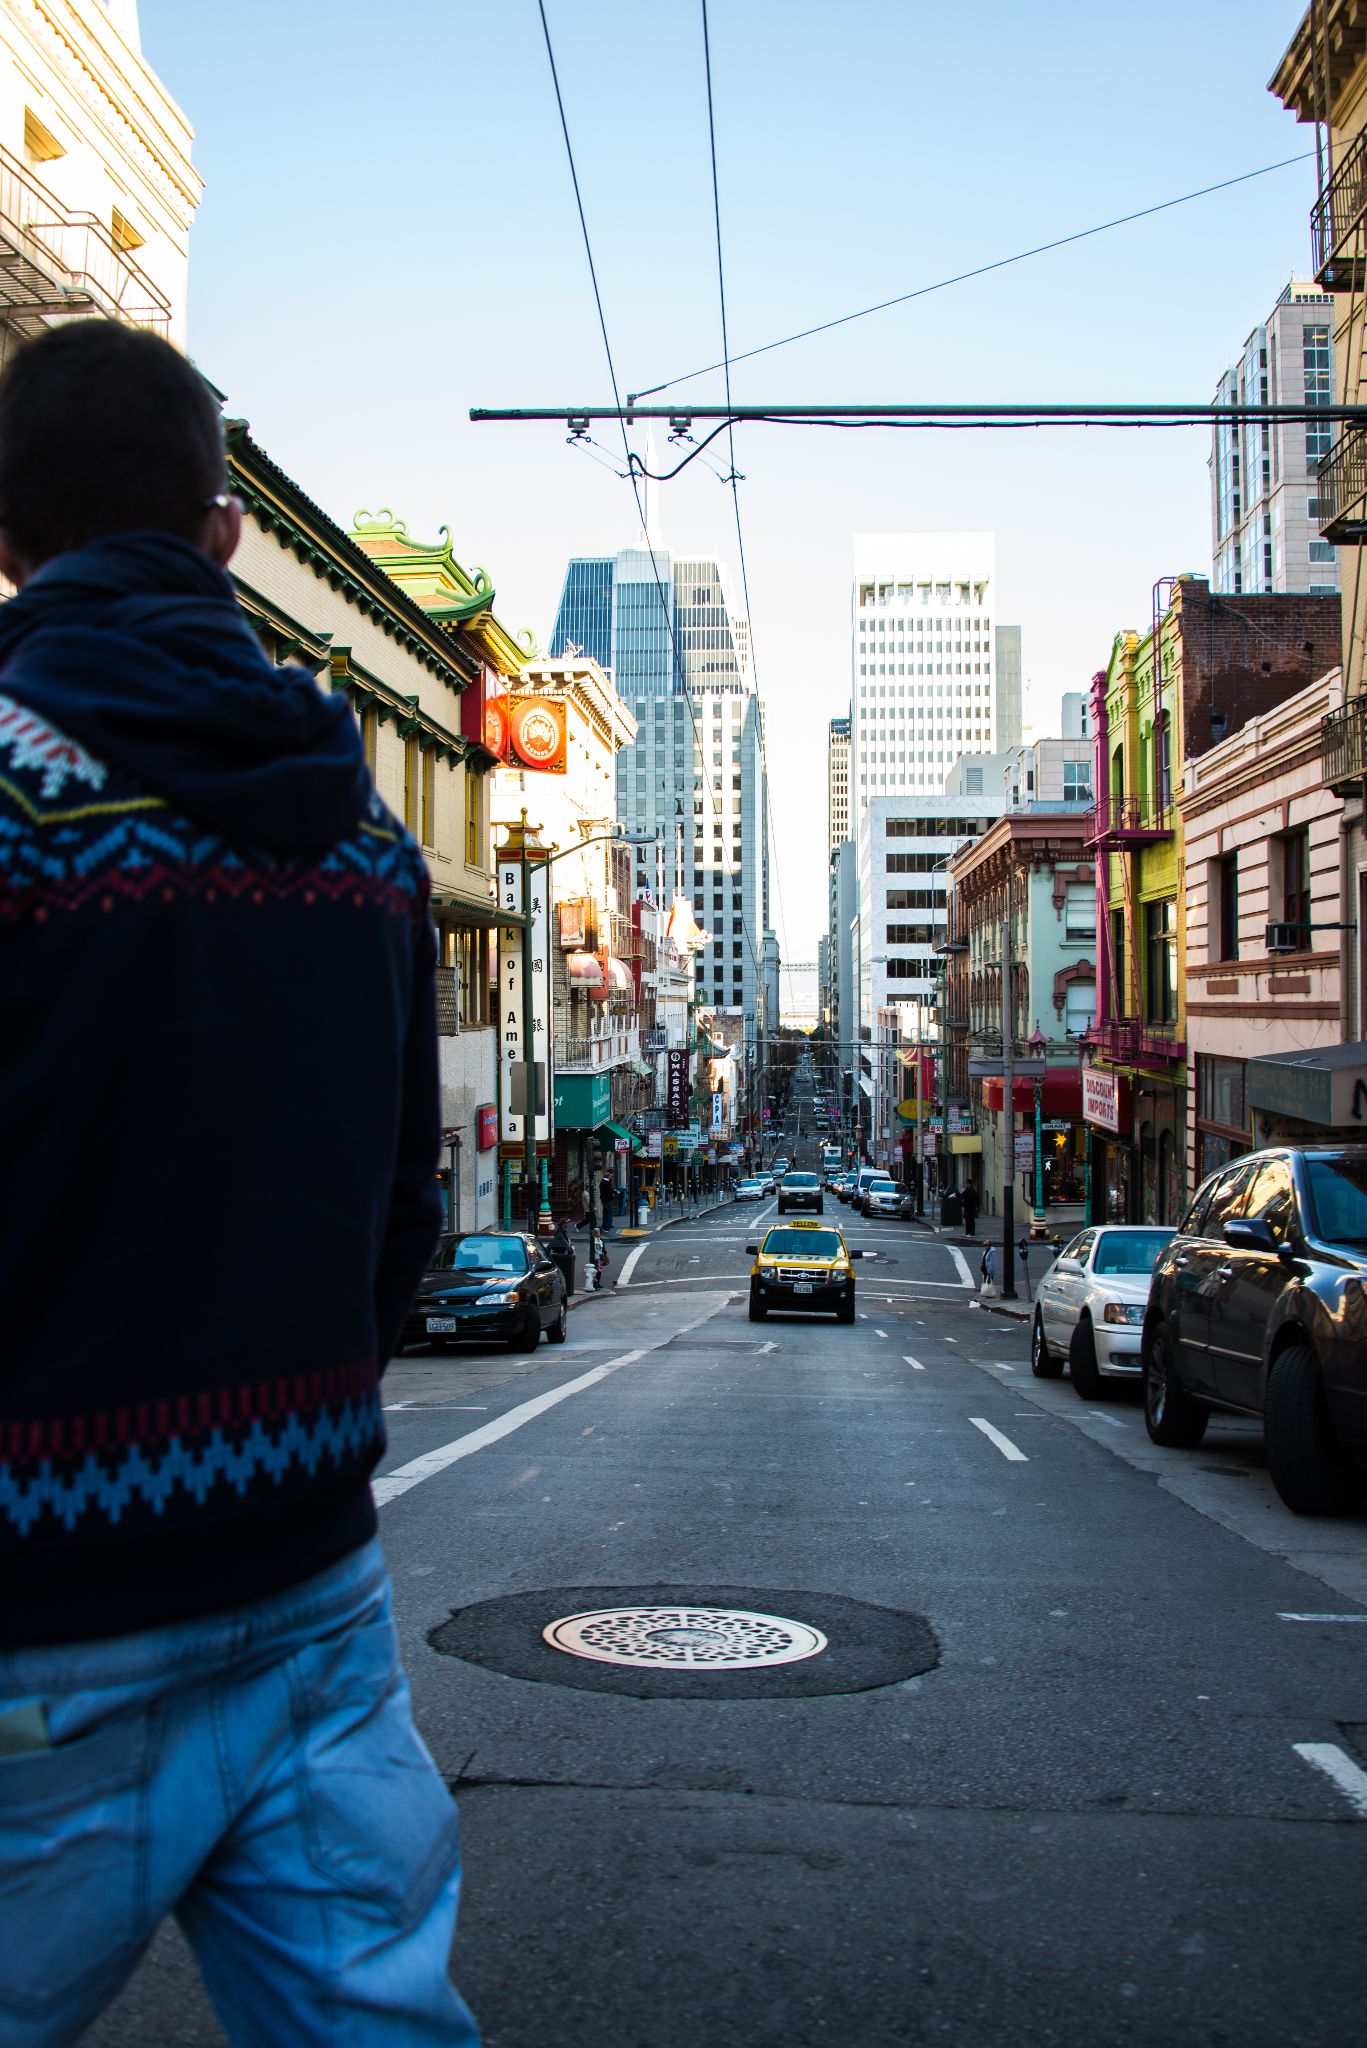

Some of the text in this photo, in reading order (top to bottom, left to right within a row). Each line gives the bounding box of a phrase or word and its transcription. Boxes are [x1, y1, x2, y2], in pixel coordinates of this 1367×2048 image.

[504, 872, 518, 1133] Bak of Amea
[1087, 1098, 1115, 1120] IMPORTS
[792, 1220, 819, 1228] YELLOW
